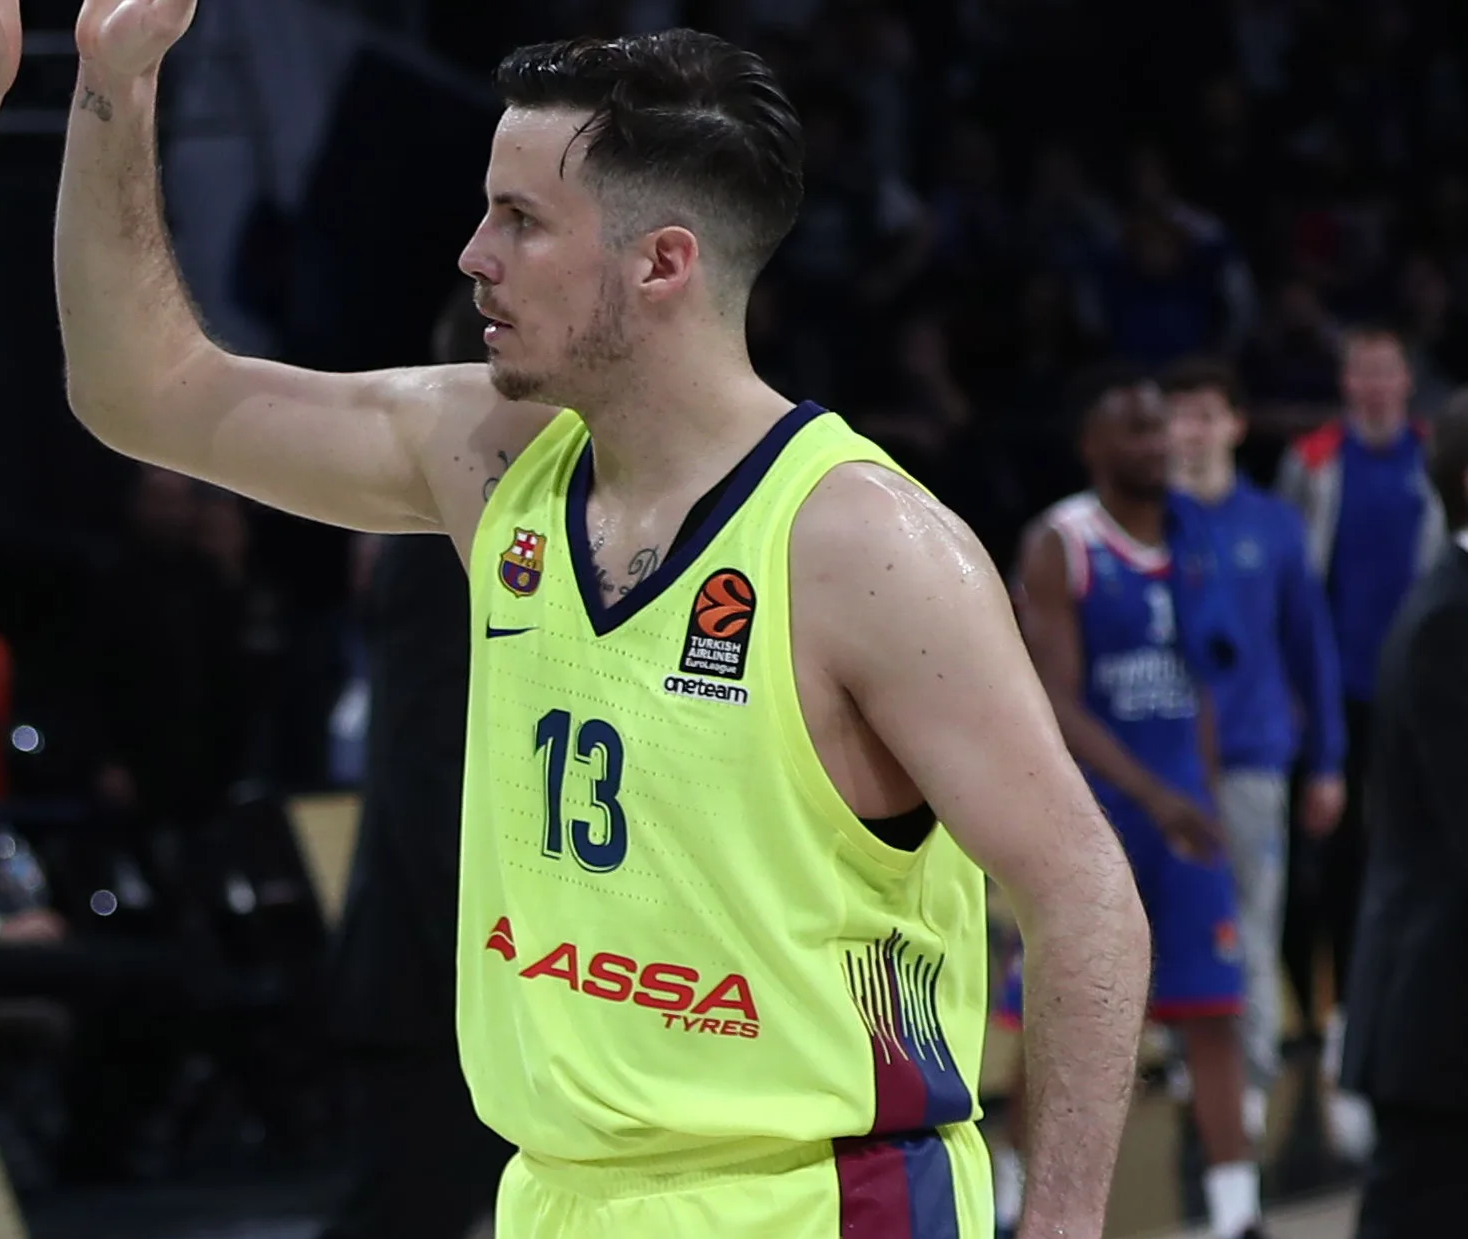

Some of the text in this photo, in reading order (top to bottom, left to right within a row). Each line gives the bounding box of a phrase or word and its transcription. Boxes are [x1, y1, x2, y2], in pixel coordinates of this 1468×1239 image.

[688, 647, 740, 664] AIRLINES
[690, 635, 742, 653] TURKISH
[664, 676, 749, 704] oneteam
[533, 708, 629, 874] 13
[661, 1012, 761, 1040] TYRES
